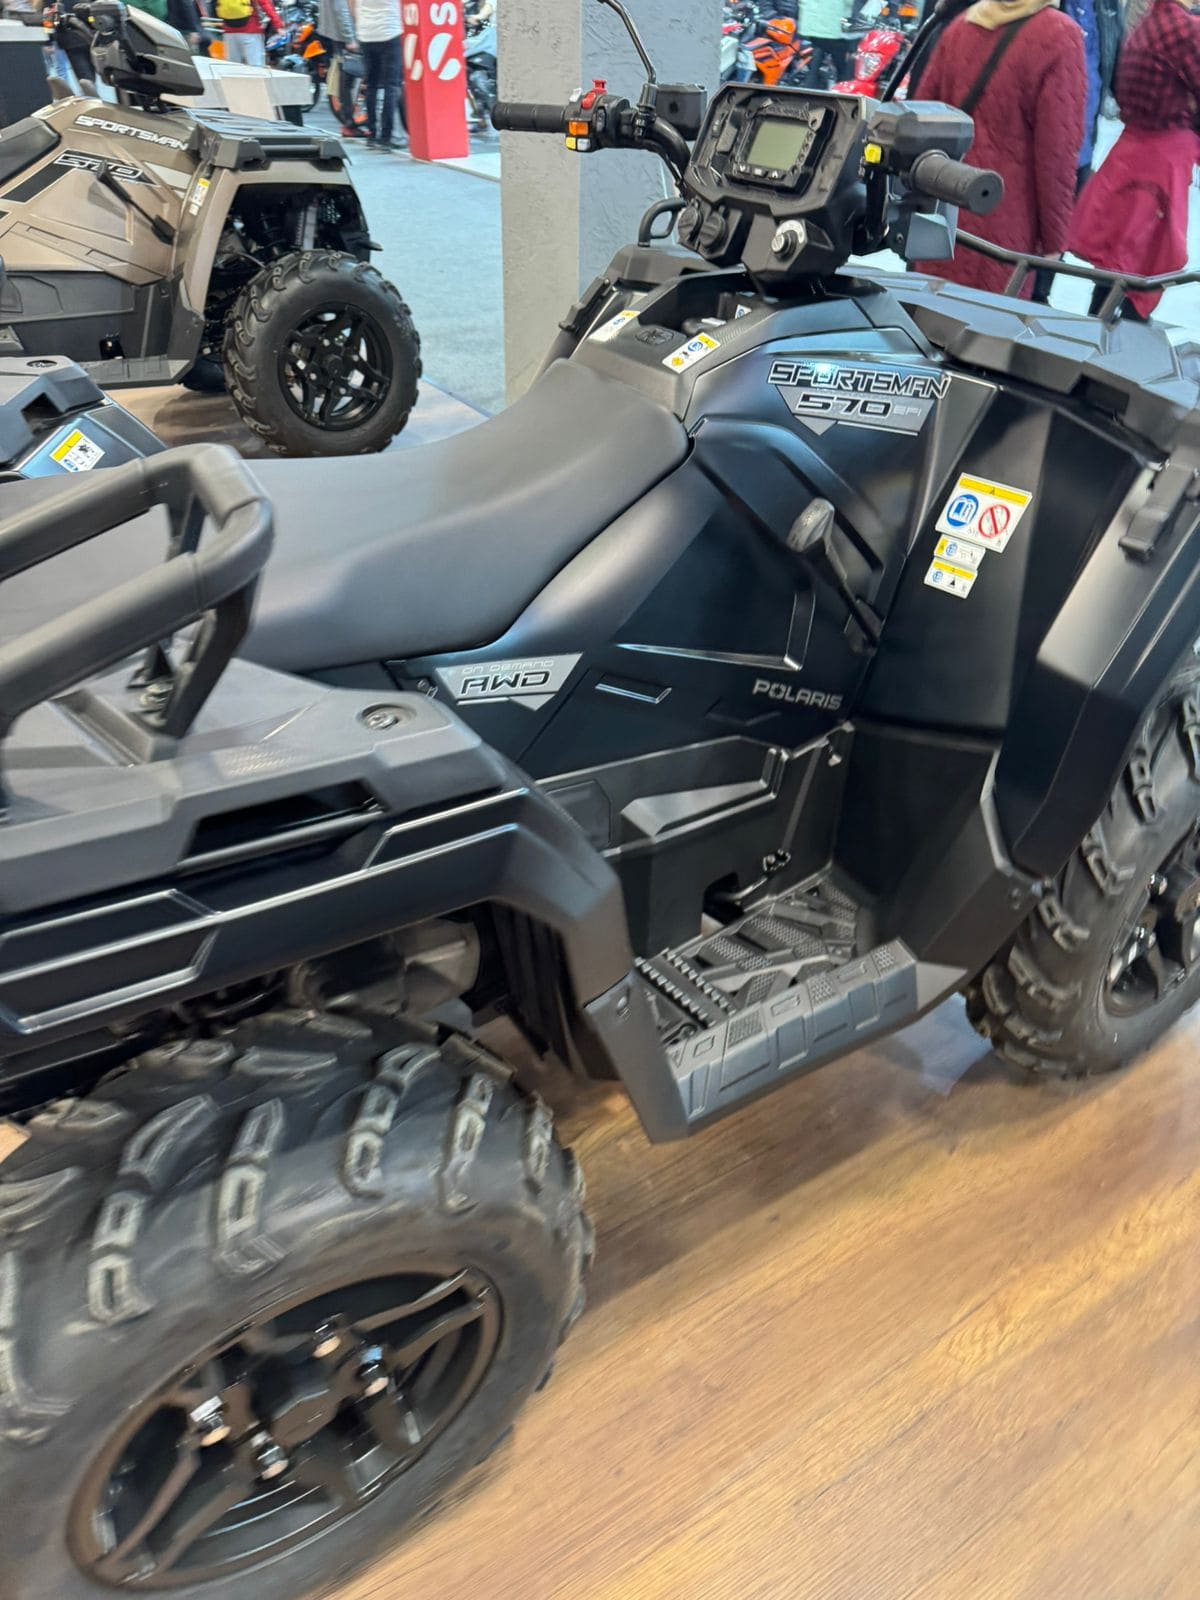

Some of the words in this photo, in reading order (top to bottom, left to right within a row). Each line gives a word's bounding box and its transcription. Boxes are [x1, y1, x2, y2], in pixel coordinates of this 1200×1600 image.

[74, 114, 189, 150] SPORTSMAN
[767, 360, 952, 400] SPORTSMAN
[796, 391, 892, 418] 570
[461, 666, 484, 675] ON
[489, 659, 555, 672] DEMAND
[460, 670, 551, 696] AWD
[752, 679, 844, 711] POLARIS
